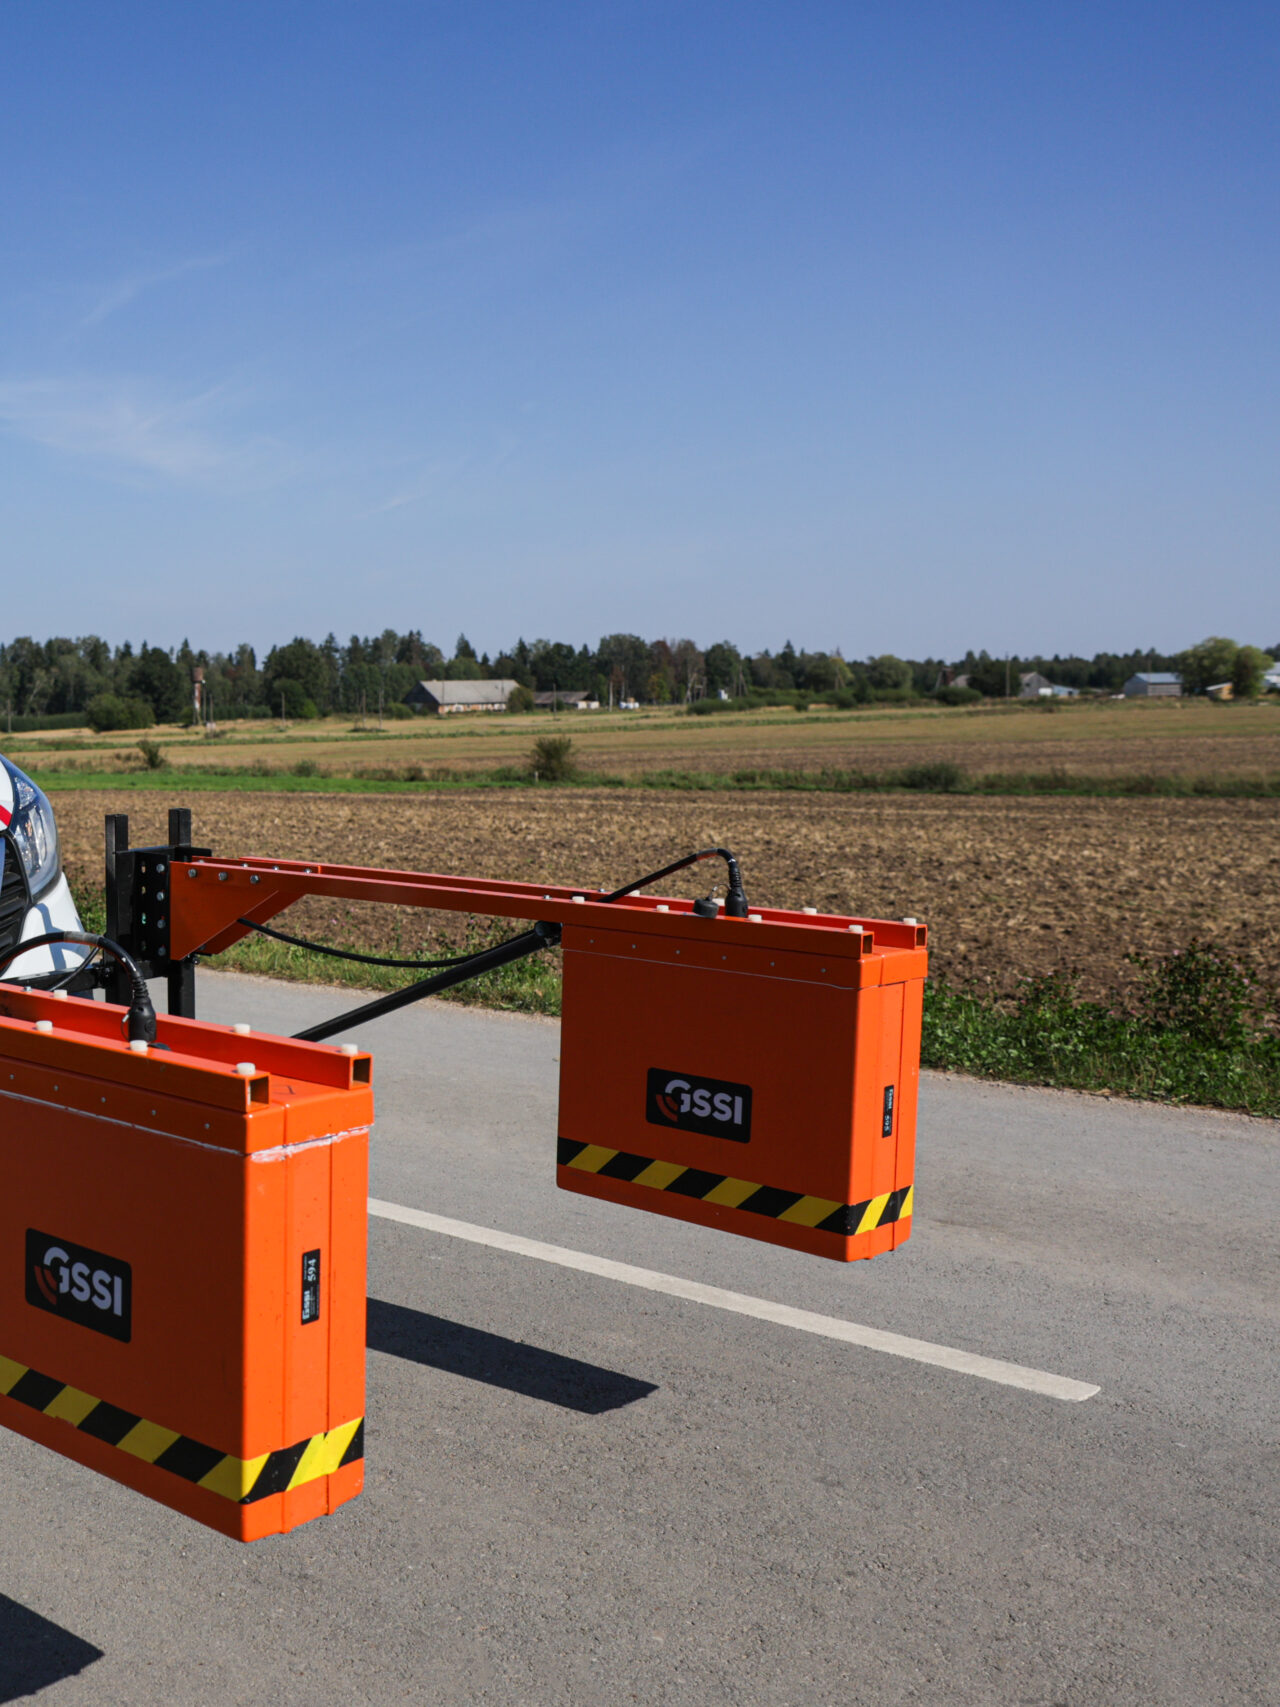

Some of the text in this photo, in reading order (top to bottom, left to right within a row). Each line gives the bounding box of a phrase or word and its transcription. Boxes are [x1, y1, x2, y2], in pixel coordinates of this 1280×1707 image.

[657, 1079, 743, 1125] GSSI
[35, 1246, 123, 1317] GSSI
[307, 1258, 317, 1282] 594
